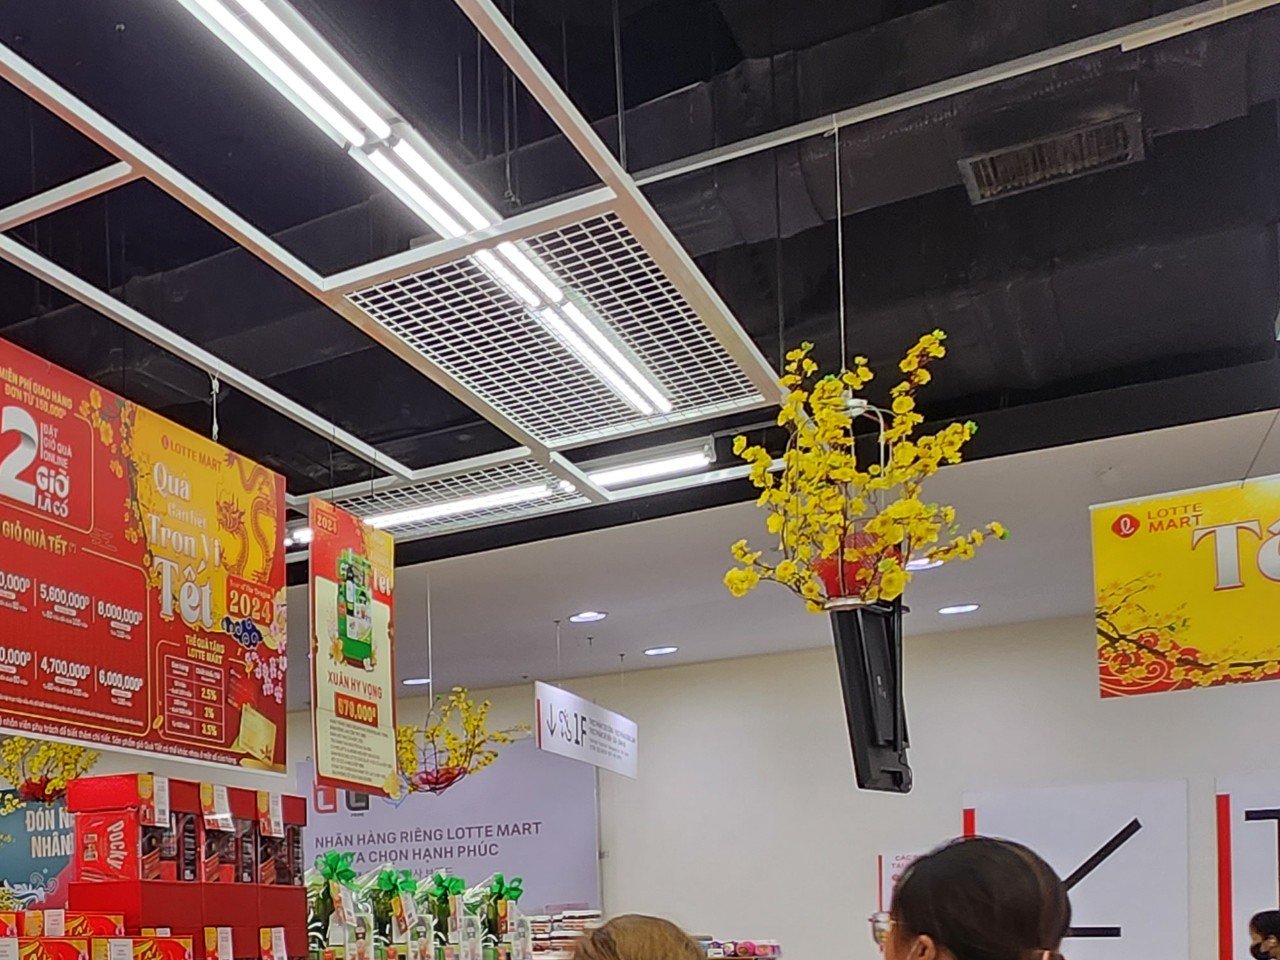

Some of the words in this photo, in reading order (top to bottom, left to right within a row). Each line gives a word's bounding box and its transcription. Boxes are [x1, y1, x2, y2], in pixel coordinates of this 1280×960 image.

[43, 451, 68, 468] ONLINE
[169, 439, 197, 462] LOTTE
[197, 453, 221, 473] MART
[153, 460, 191, 501] Quà
[38, 494, 51, 512] LÀ
[1147, 503, 1203, 520] LOTTE
[1148, 513, 1204, 533] MART
[2, 518, 23, 543] GIỎ
[24, 523, 48, 549] QUÀ
[48, 533, 68, 557] TẾT
[153, 555, 214, 630] Tết
[229, 589, 271, 623] 2024
[187, 647, 206, 658] LOTTE
[206, 652, 223, 665] MART
[197, 639, 209, 650] QUÀ
[201, 688, 217, 701] 2.5%
[327, 670, 350, 690] XUÂN
[350, 678, 362, 693] HY
[362, 678, 383, 700] VỌNG
[574, 713, 587, 747] 1F
[25, 806, 56, 833] ĐÓN
[58, 806, 75, 830] N
[315, 832, 354, 849] NHÃN
[356, 830, 397, 846] HÀNG
[400, 826, 444, 843] RIÊNG
[447, 826, 493, 841] LOTTE
[496, 821, 542, 837] MART
[369, 850, 409, 865] CHỌN
[412, 847, 454, 864] HẠNH
[457, 840, 499, 857] PHÚC
